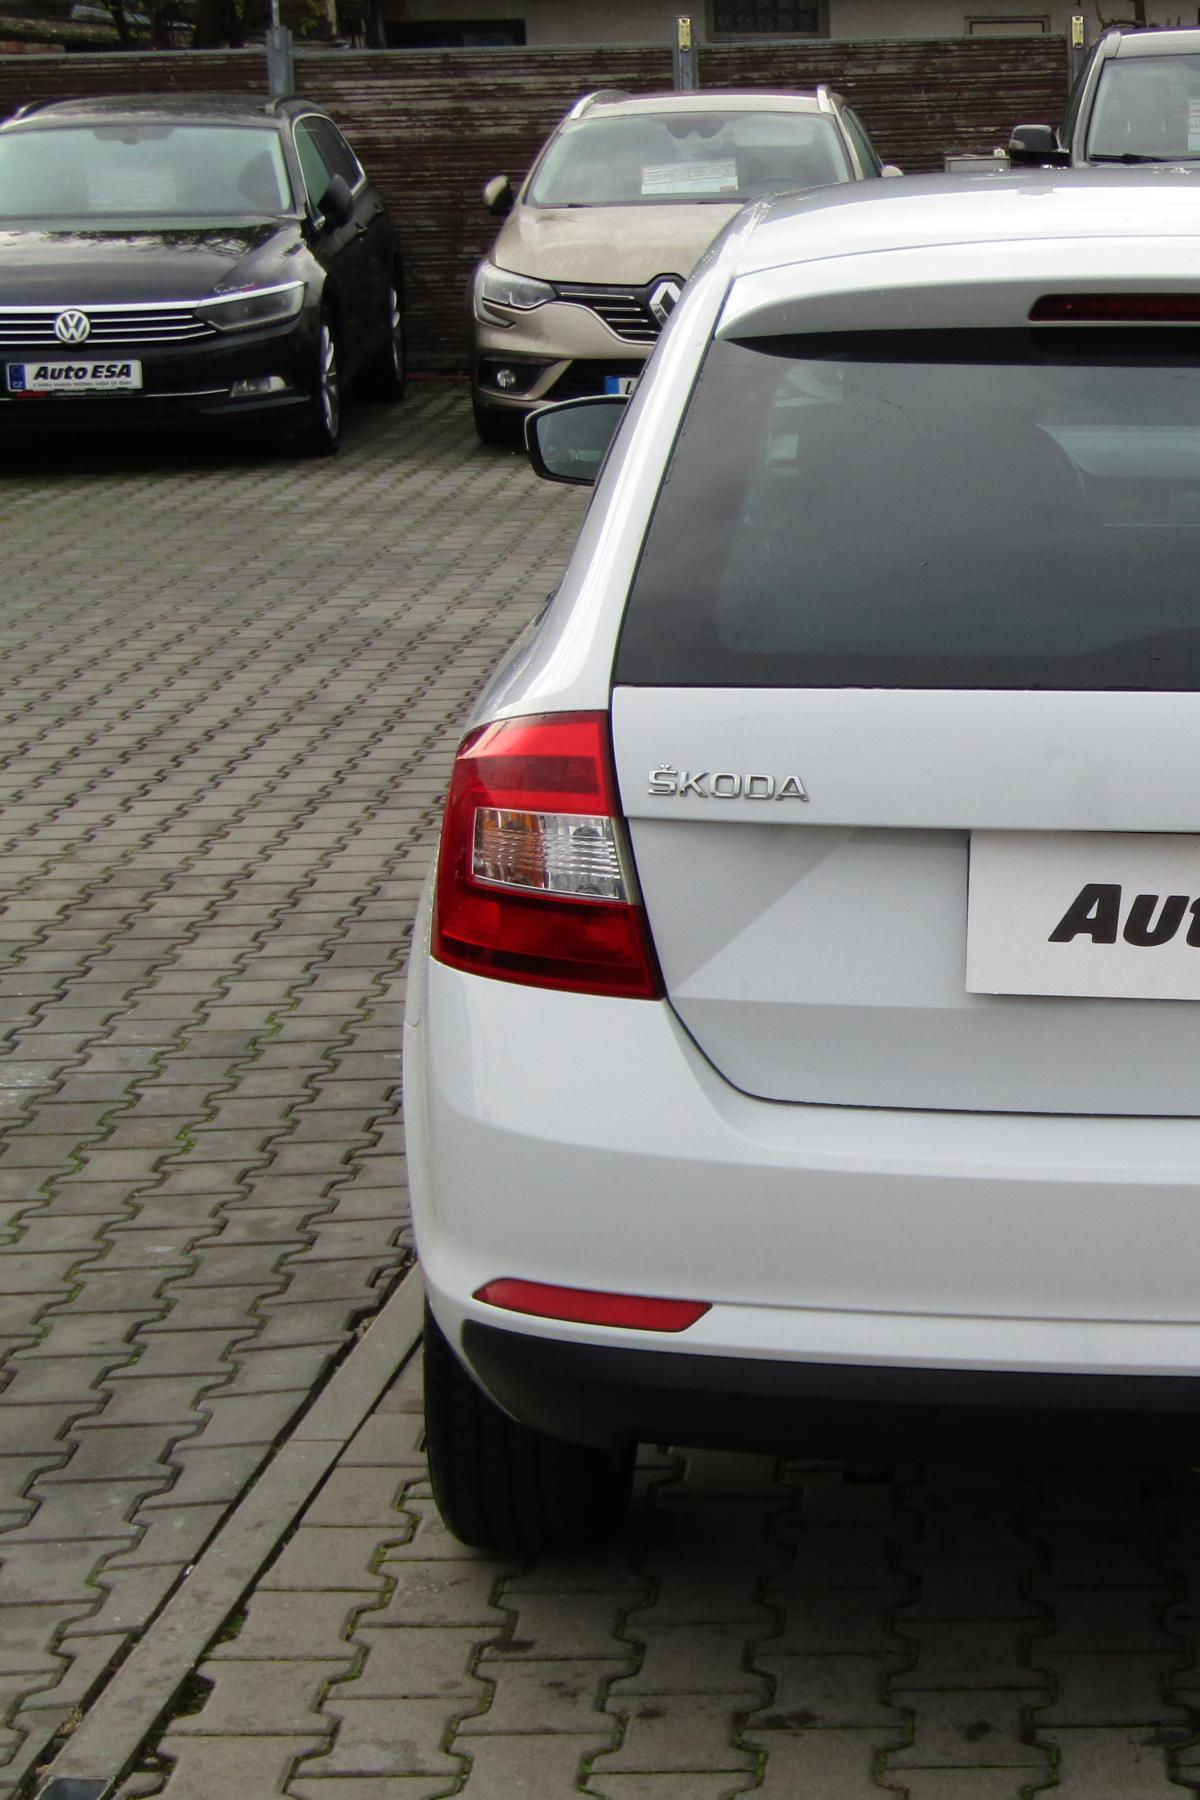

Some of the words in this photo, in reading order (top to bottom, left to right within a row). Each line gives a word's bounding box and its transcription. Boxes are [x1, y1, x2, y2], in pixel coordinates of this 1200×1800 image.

[33, 365, 88, 381] Auto
[91, 363, 132, 380] ESA
[646, 764, 811, 803] ŠKODA
